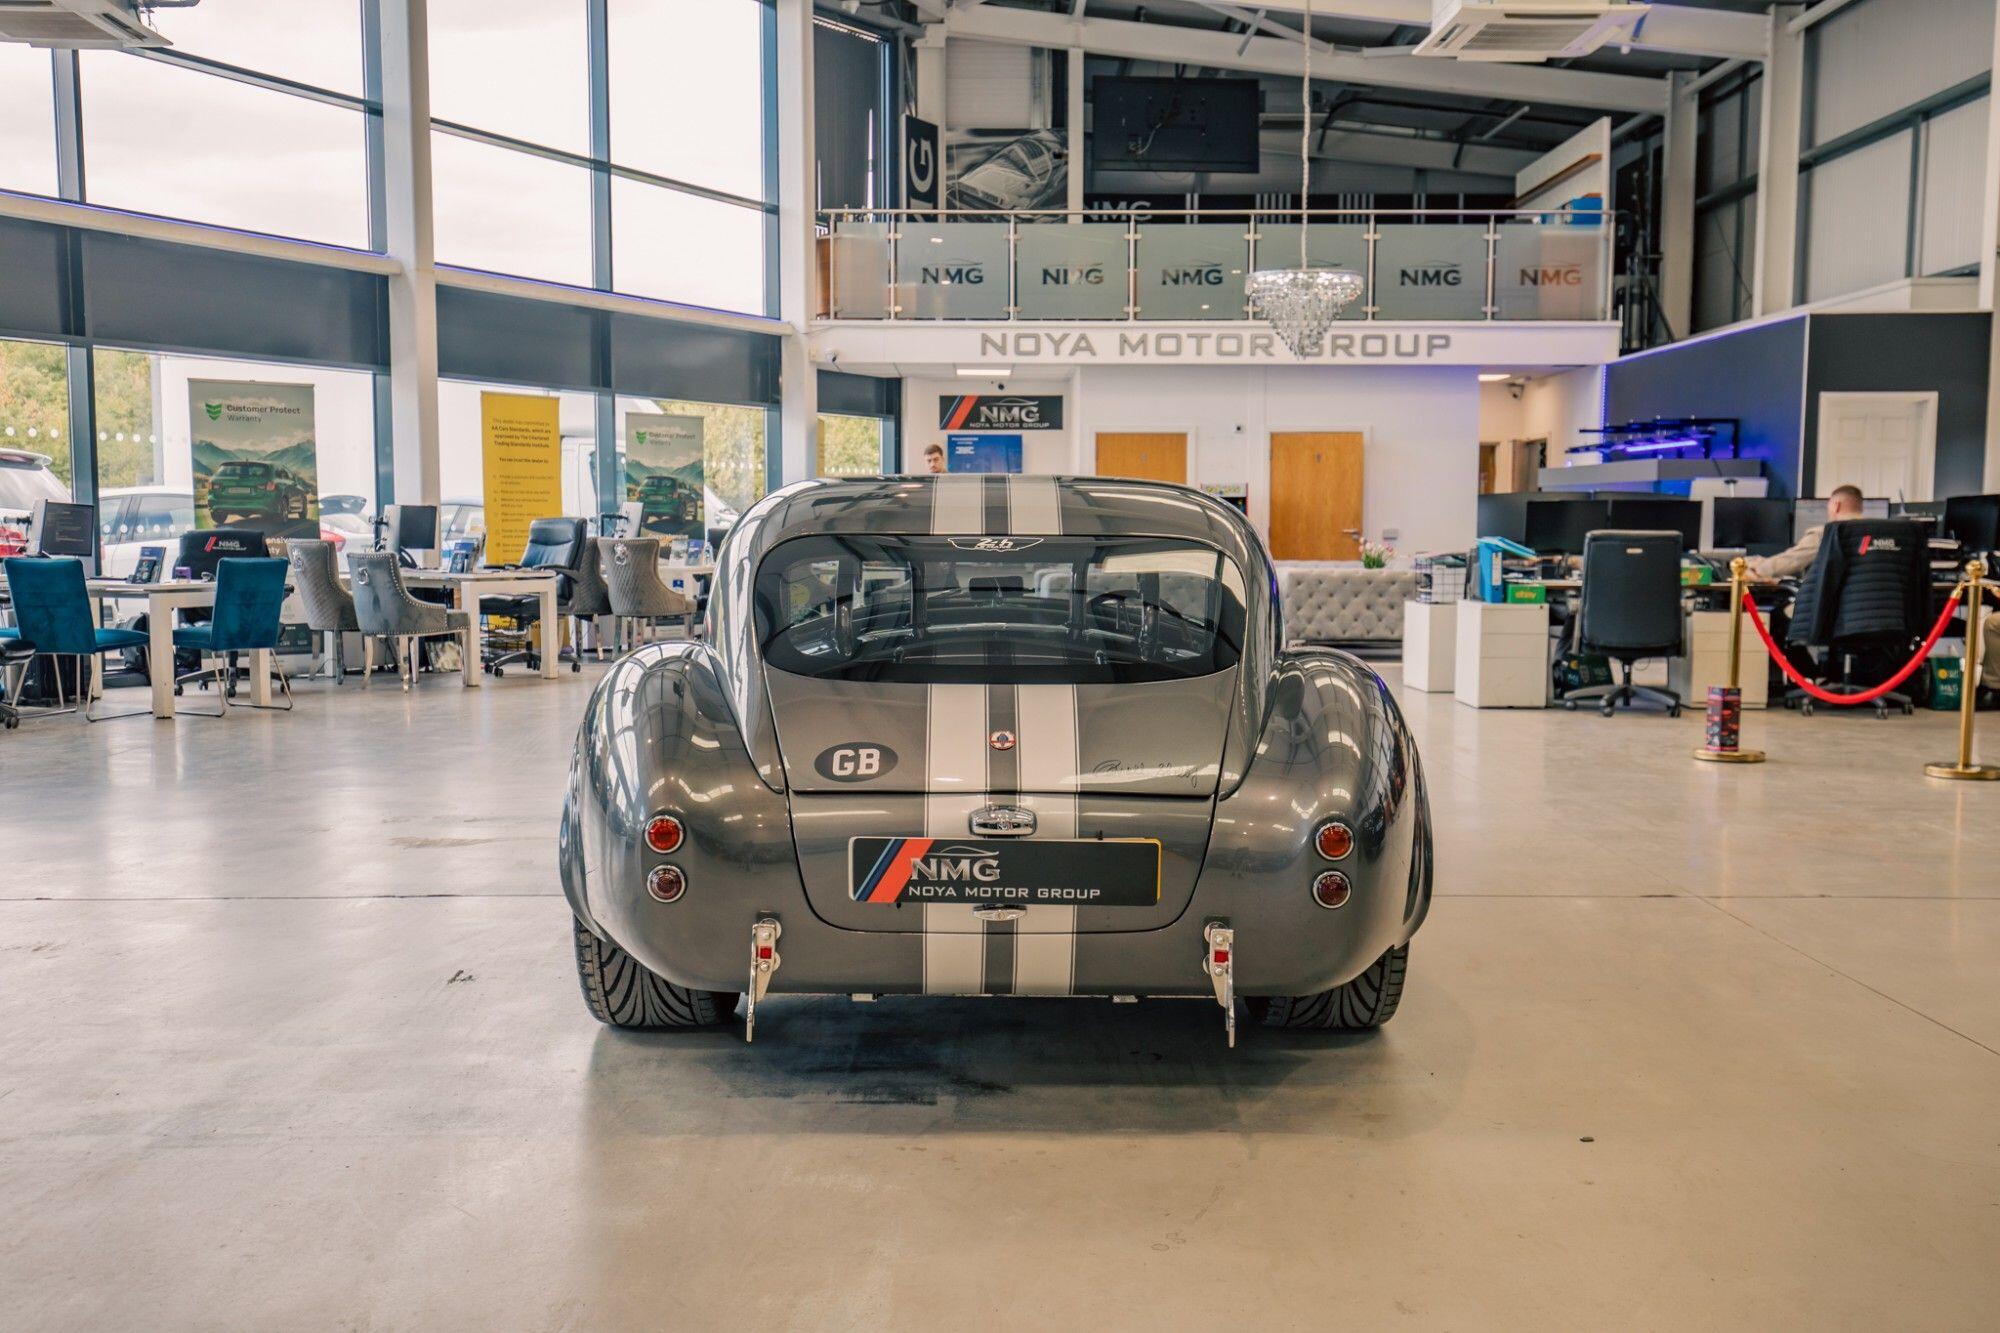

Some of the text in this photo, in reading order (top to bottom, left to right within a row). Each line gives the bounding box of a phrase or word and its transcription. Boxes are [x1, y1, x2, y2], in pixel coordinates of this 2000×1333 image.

[922, 267, 983, 284] NMG
[1161, 268, 1223, 285] NMG
[1400, 268, 1462, 286] NMG
[1519, 268, 1582, 286] NMG
[980, 332, 1096, 356] NOYA
[1119, 332, 1276, 357] MOTOR
[226, 404, 301, 414] Customer Protect
[979, 405, 1040, 423] NMG
[227, 415, 262, 423] Warranty
[832, 748, 880, 776] GB
[910, 857, 1000, 881] NMG
[908, 886, 1101, 899] NOYA MOTOR GROUP
